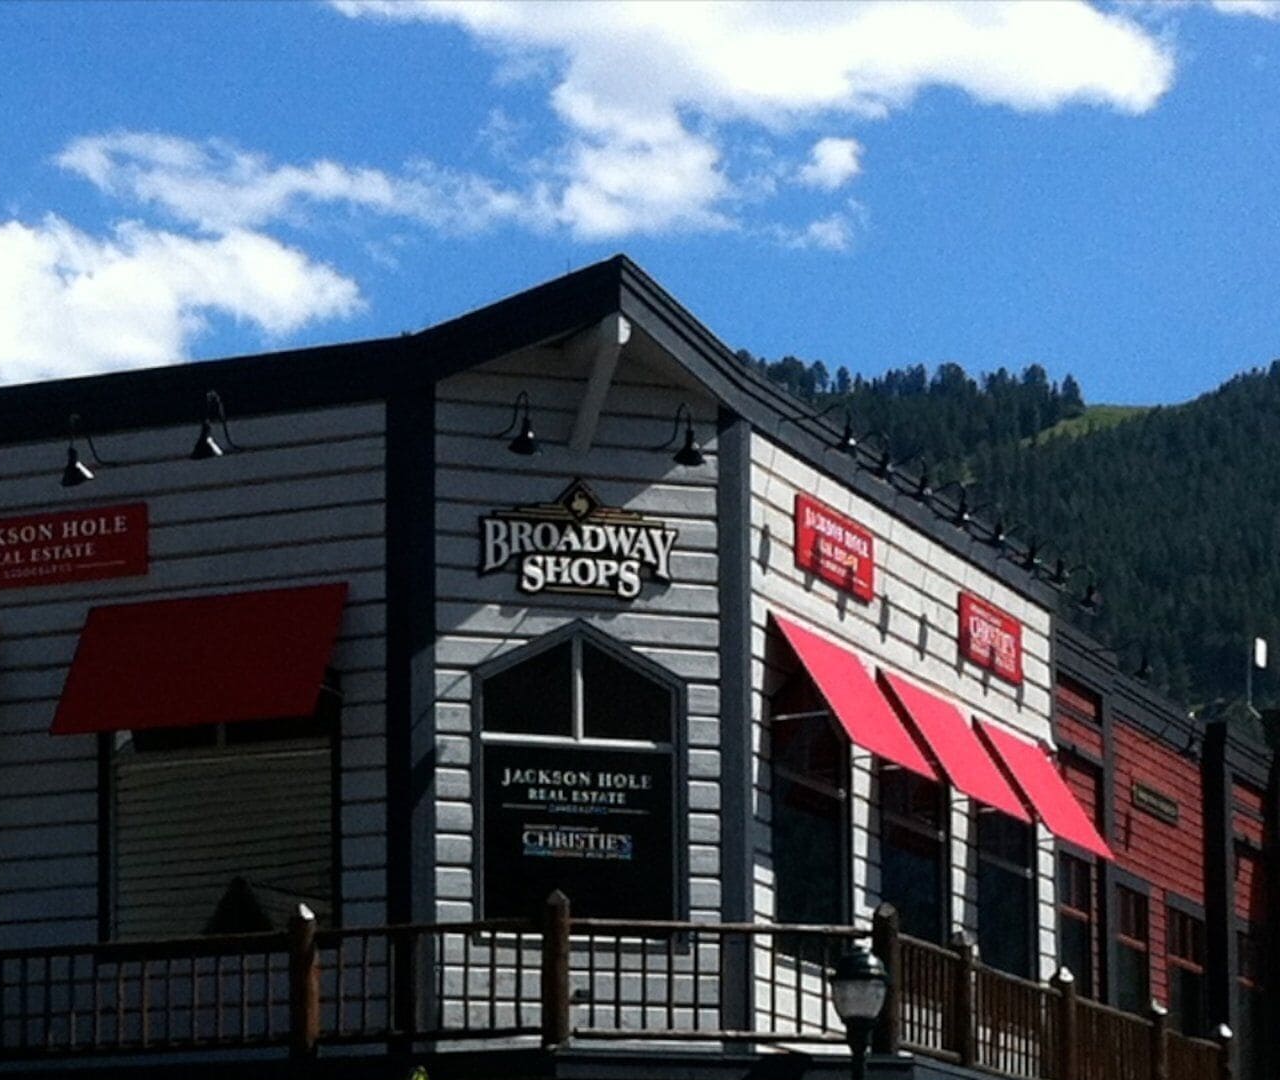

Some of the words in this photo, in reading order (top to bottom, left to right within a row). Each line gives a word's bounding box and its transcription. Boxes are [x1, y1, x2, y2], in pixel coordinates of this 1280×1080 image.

[62, 515, 129, 539] HOLE
[30, 542, 97, 563] ESTATE
[482, 517, 677, 579] BROADWAY
[521, 554, 642, 599] SHOPS
[500, 767, 592, 788] JACKSON
[597, 771, 653, 791] HOLE
[527, 787, 568, 802] REAL
[571, 789, 627, 805] ESTATE
